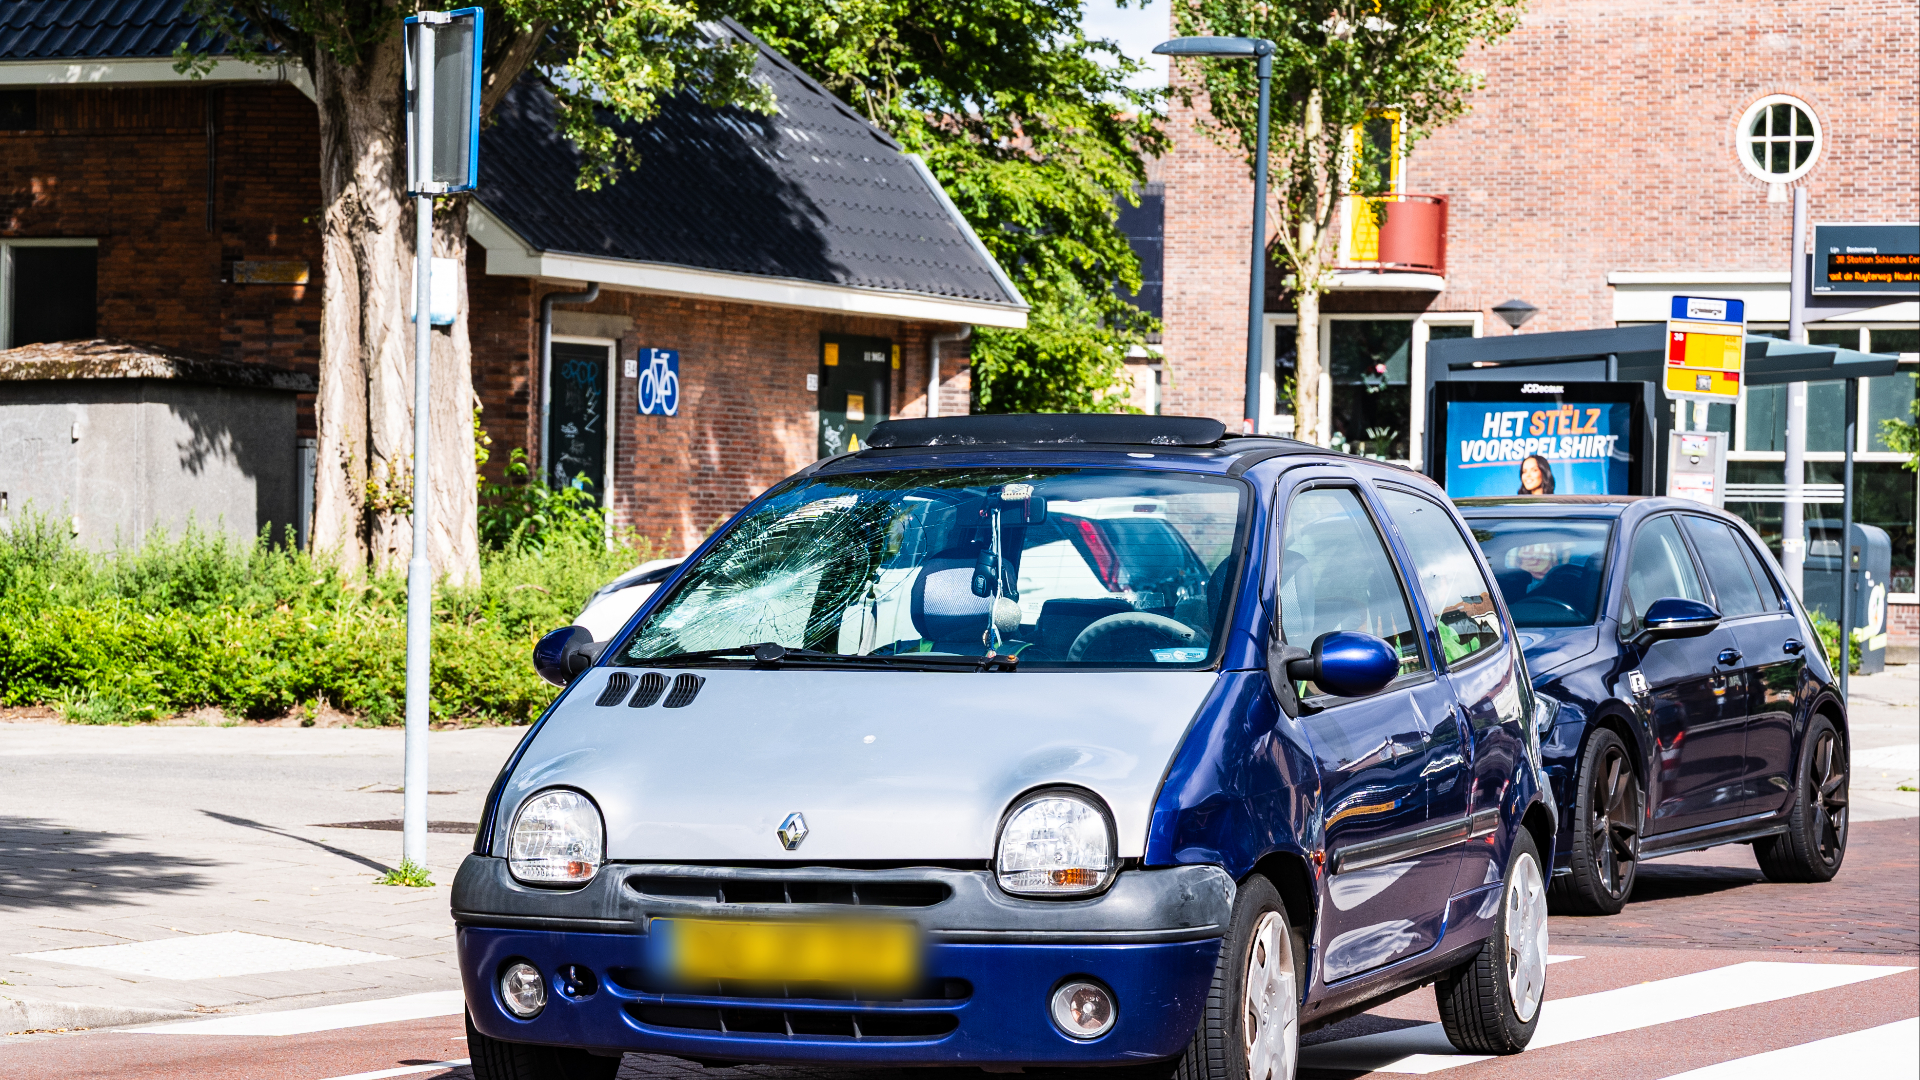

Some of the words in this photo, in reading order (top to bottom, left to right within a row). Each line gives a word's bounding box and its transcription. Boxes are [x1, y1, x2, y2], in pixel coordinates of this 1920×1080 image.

[1835, 255, 1845, 264] 38
[1846, 254, 1874, 264] Station
[1875, 254, 1907, 264] Schiedam
[1673, 332, 1684, 342] 38
[1520, 383, 1564, 393] JCDecaux
[1482, 410, 1529, 438] HET
[1529, 404, 1601, 436] STËLZ
[1460, 435, 1618, 462] VOORSPELSHIRT
